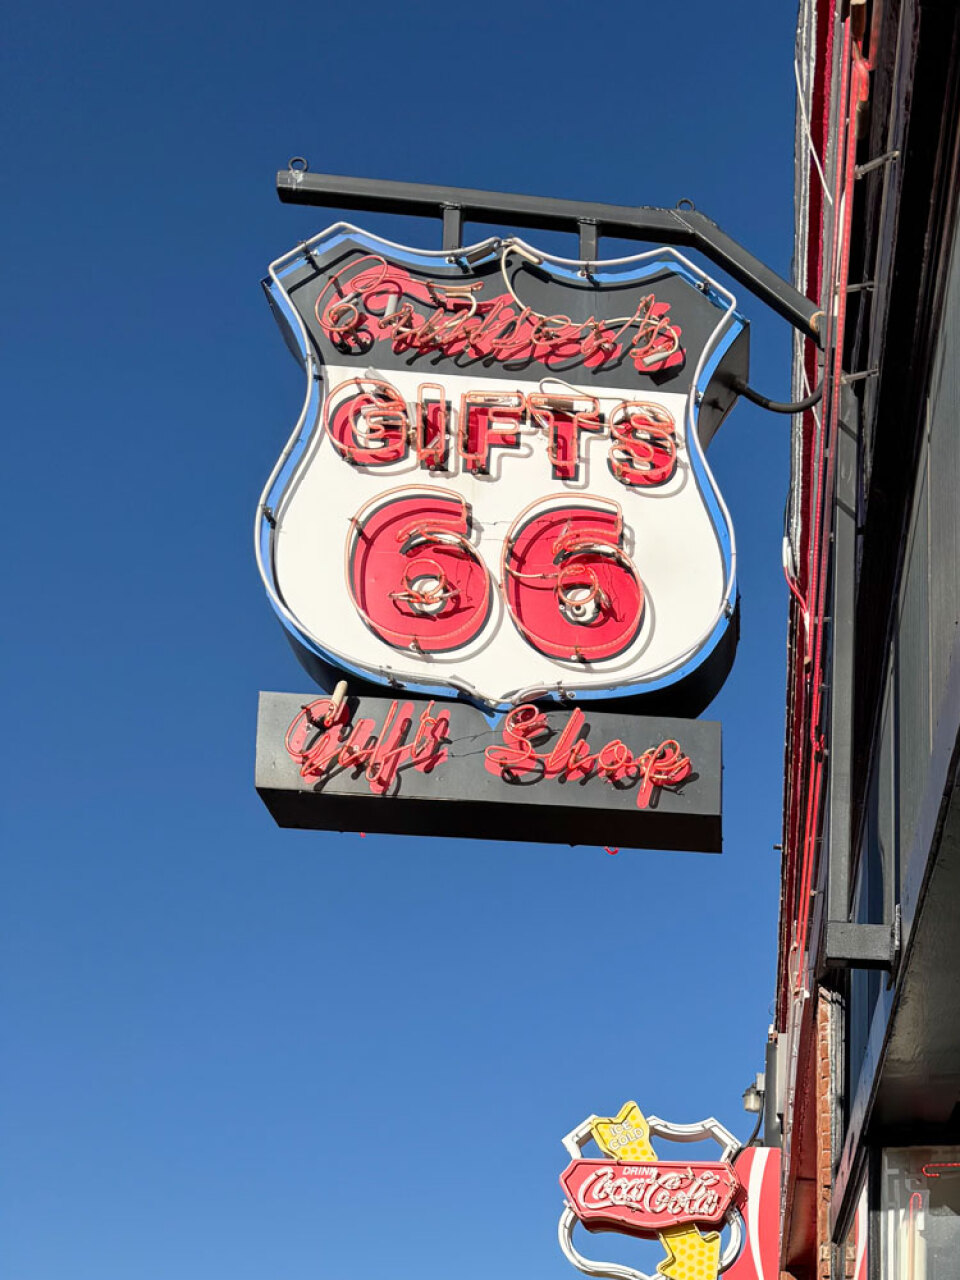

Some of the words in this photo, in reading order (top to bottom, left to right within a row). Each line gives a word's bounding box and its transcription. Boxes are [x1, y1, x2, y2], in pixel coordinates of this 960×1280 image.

[325, 379, 679, 487] GIFTS
[344, 484, 645, 662] 66
[285, 698, 450, 795] Gift
[485, 704, 692, 808] Shop
[609, 1128, 645, 1151] COLD
[611, 1120, 633, 1137] ICE
